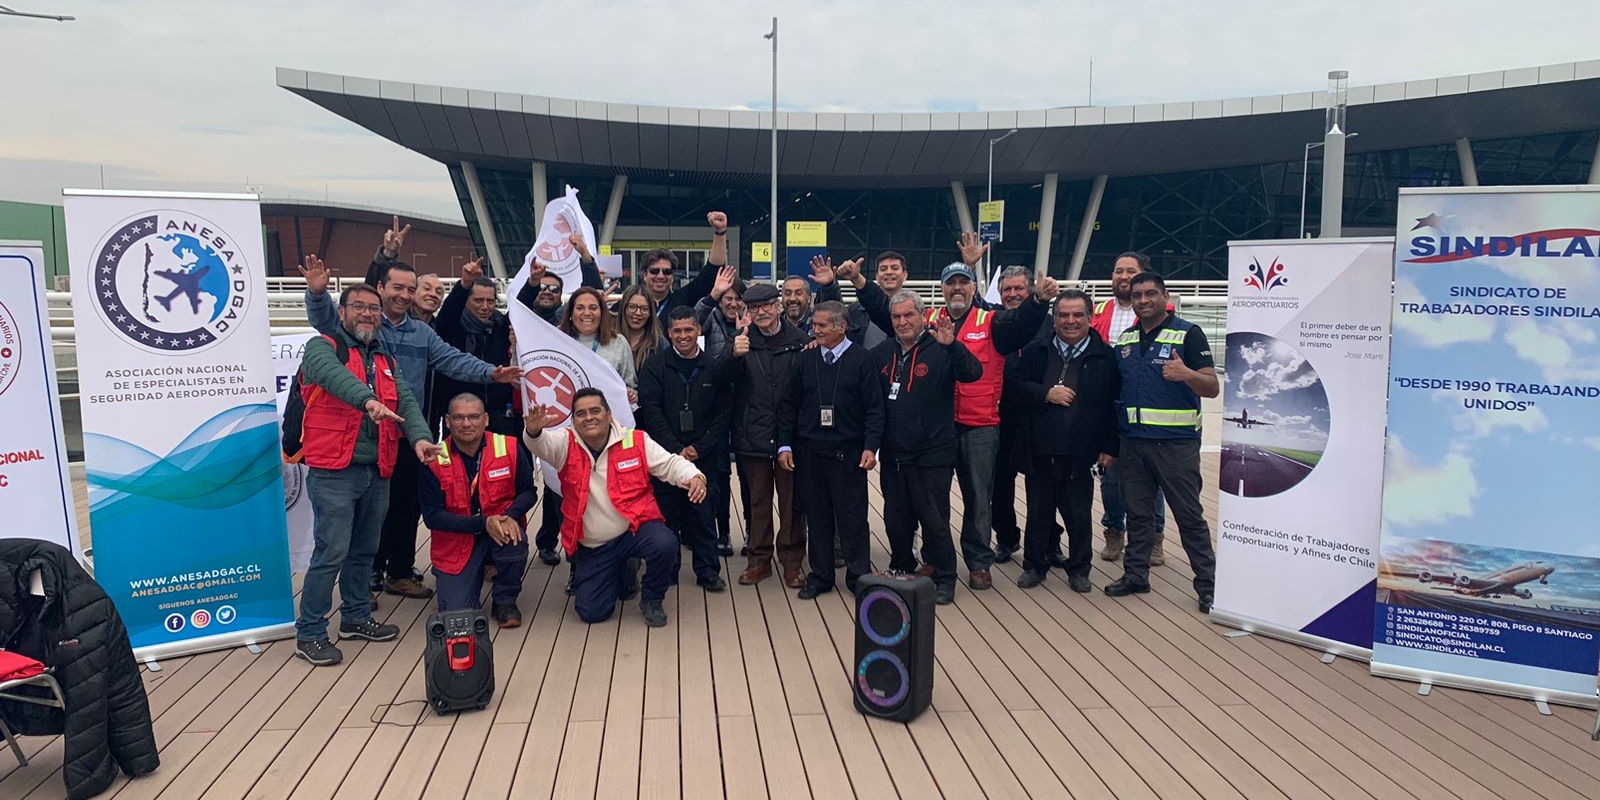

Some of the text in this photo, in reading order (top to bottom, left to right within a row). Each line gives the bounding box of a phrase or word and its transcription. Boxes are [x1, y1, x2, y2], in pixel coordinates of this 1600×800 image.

[762, 248, 769, 256] 6
[1410, 236, 1600, 257] SINDILA
[166, 220, 245, 333] ANESA DGAC
[1450, 286, 1567, 299] SINDICATO DE
[1232, 301, 1299, 309] AEROPORTUARIOS
[1400, 303, 1530, 316] TRABAJADORES
[1300, 321, 1307, 329] El
[1308, 322, 1334, 330] primer
[1306, 341, 1332, 349] mismo
[105, 364, 248, 378] ASOCIACIÓN NACIONAL
[113, 376, 244, 390] DE ESPECIALISTAS EN
[1455, 380, 1491, 392] 1990
[90, 386, 268, 404] SEGURIDAD AEROPORTUARIA
[1222, 519, 1371, 556] Confederación de Trabajadores
[1222, 531, 1376, 570] Aeroportuarios y Afines de Chile
[130, 564, 261, 589] WWW.ANESADGAC.CL
[131, 573, 261, 598] ANESADGAC@GMAIL.COM
[196, 593, 239, 604] ANESADGAC
[1396, 624, 1471, 640] SINDILANOFICIAL
[1397, 607, 1415, 616] SAN
[1416, 609, 1457, 621] ANTONIO
[1491, 620, 1511, 630] 808,
[1512, 623, 1534, 632] PISO
[1544, 628, 1593, 640] SANTIAGO
[1403, 617, 1443, 628] 26328688
[1459, 624, 1500, 636] 26389759
[1395, 639, 1479, 657] WWW.SINDILAN.CL
[1396, 631, 1506, 653] SINDICATO@SINDILAN.CL
